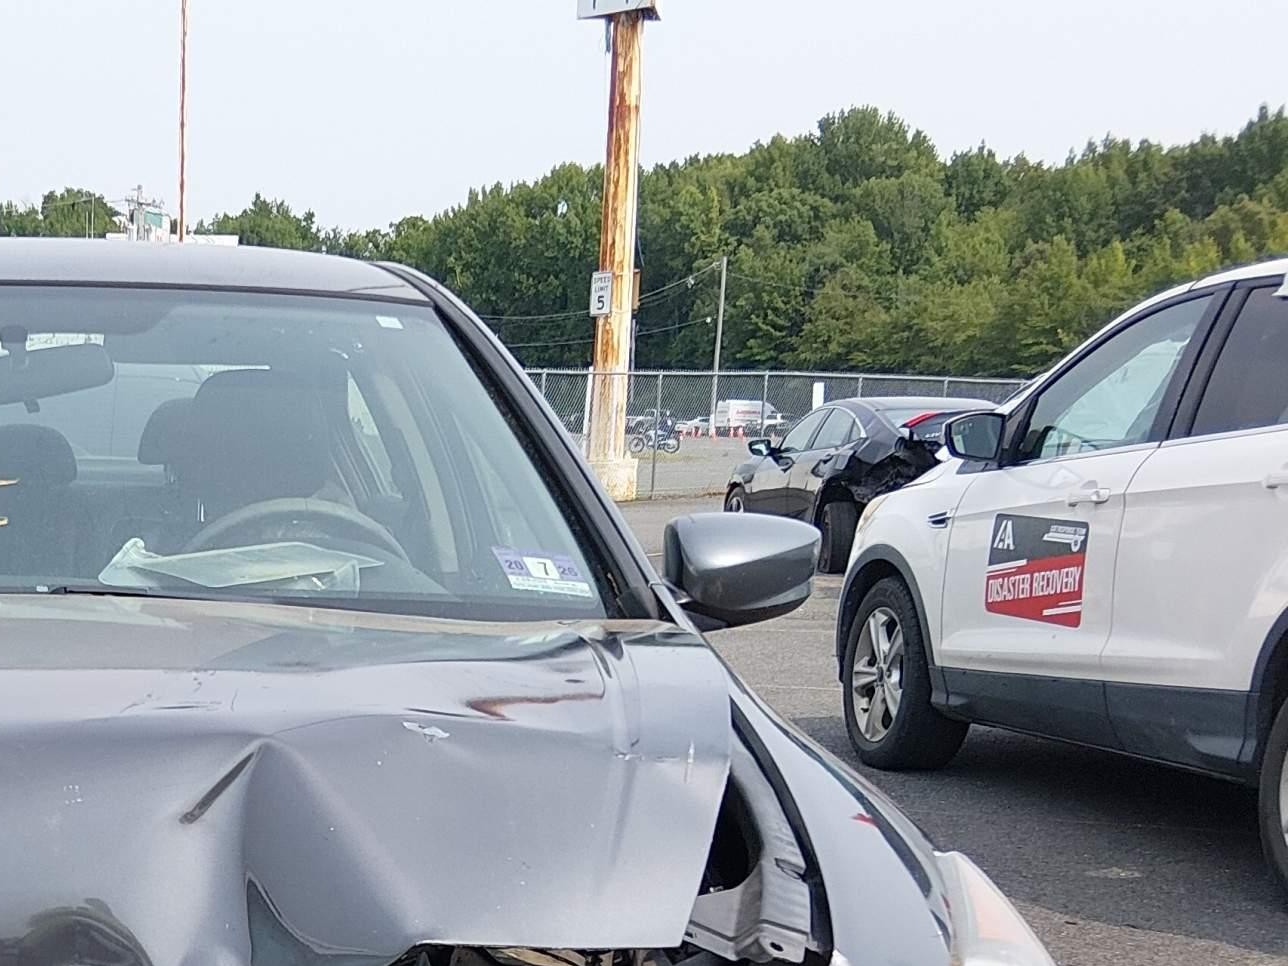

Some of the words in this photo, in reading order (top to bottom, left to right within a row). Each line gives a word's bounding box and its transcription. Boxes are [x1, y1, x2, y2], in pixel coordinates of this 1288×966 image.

[596, 295, 605, 310] 5
[536, 562, 549, 577] 7
[987, 574, 1031, 603] DISASTER
[1032, 566, 1082, 597] RECOVERY
